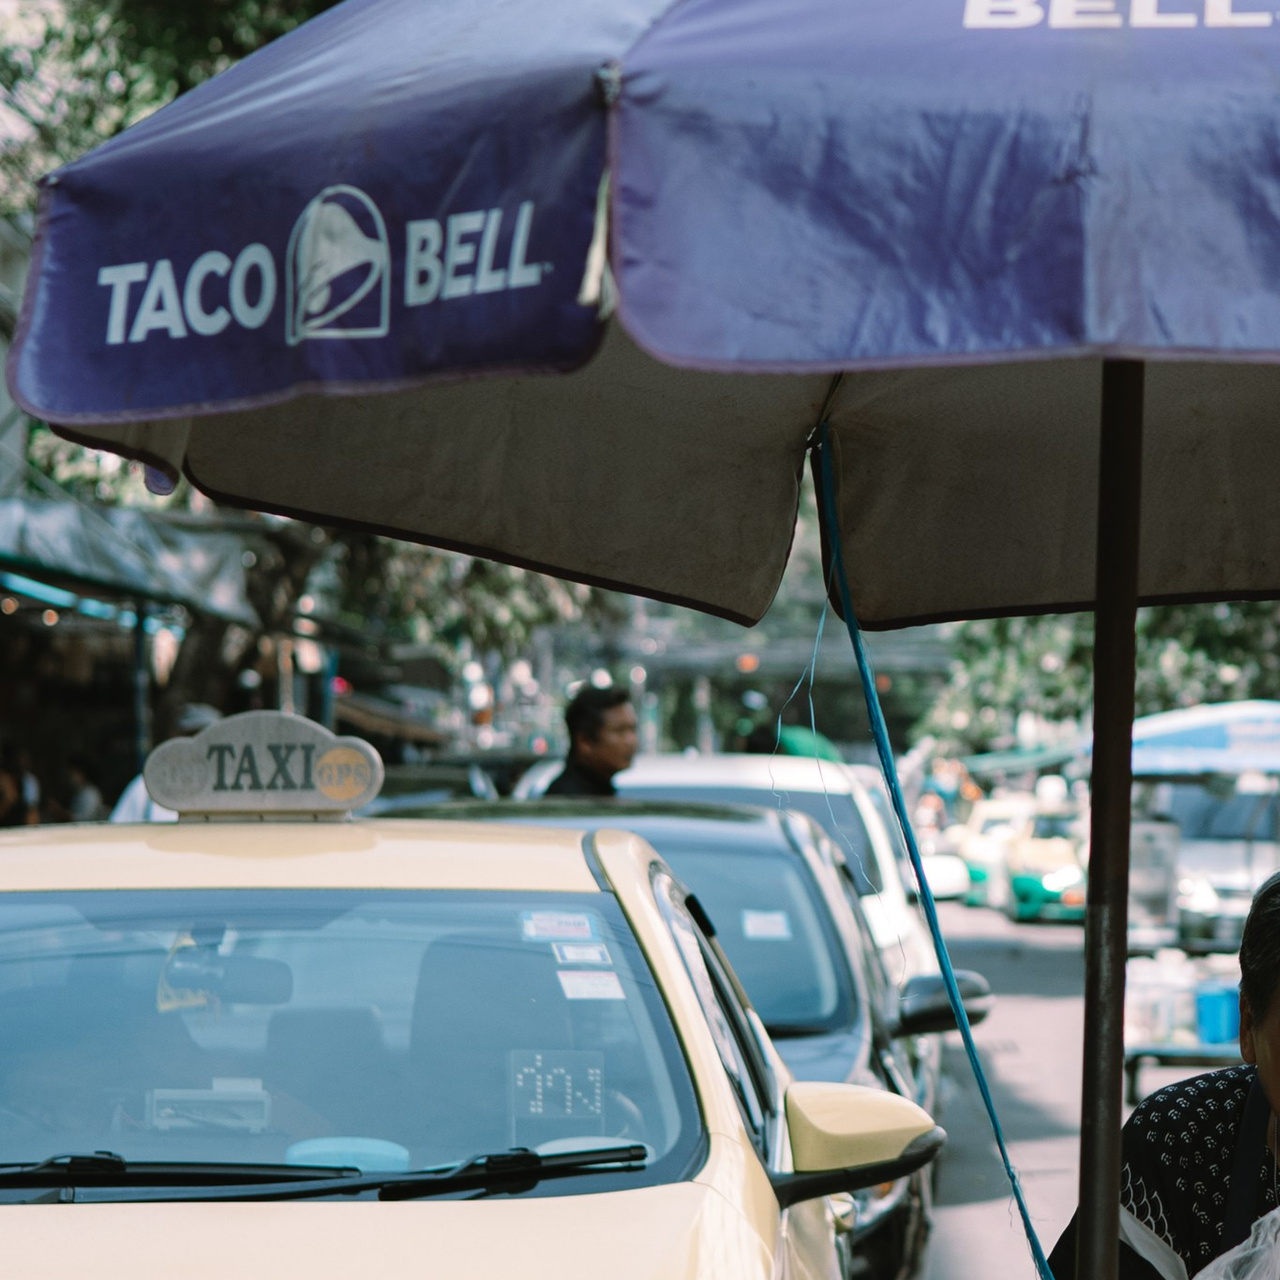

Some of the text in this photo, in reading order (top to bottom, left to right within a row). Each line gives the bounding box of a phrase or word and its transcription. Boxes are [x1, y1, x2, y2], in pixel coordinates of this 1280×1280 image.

[97, 201, 542, 345] TACO BELL
[207, 743, 316, 791] TAXI
[318, 763, 371, 787] GPS
